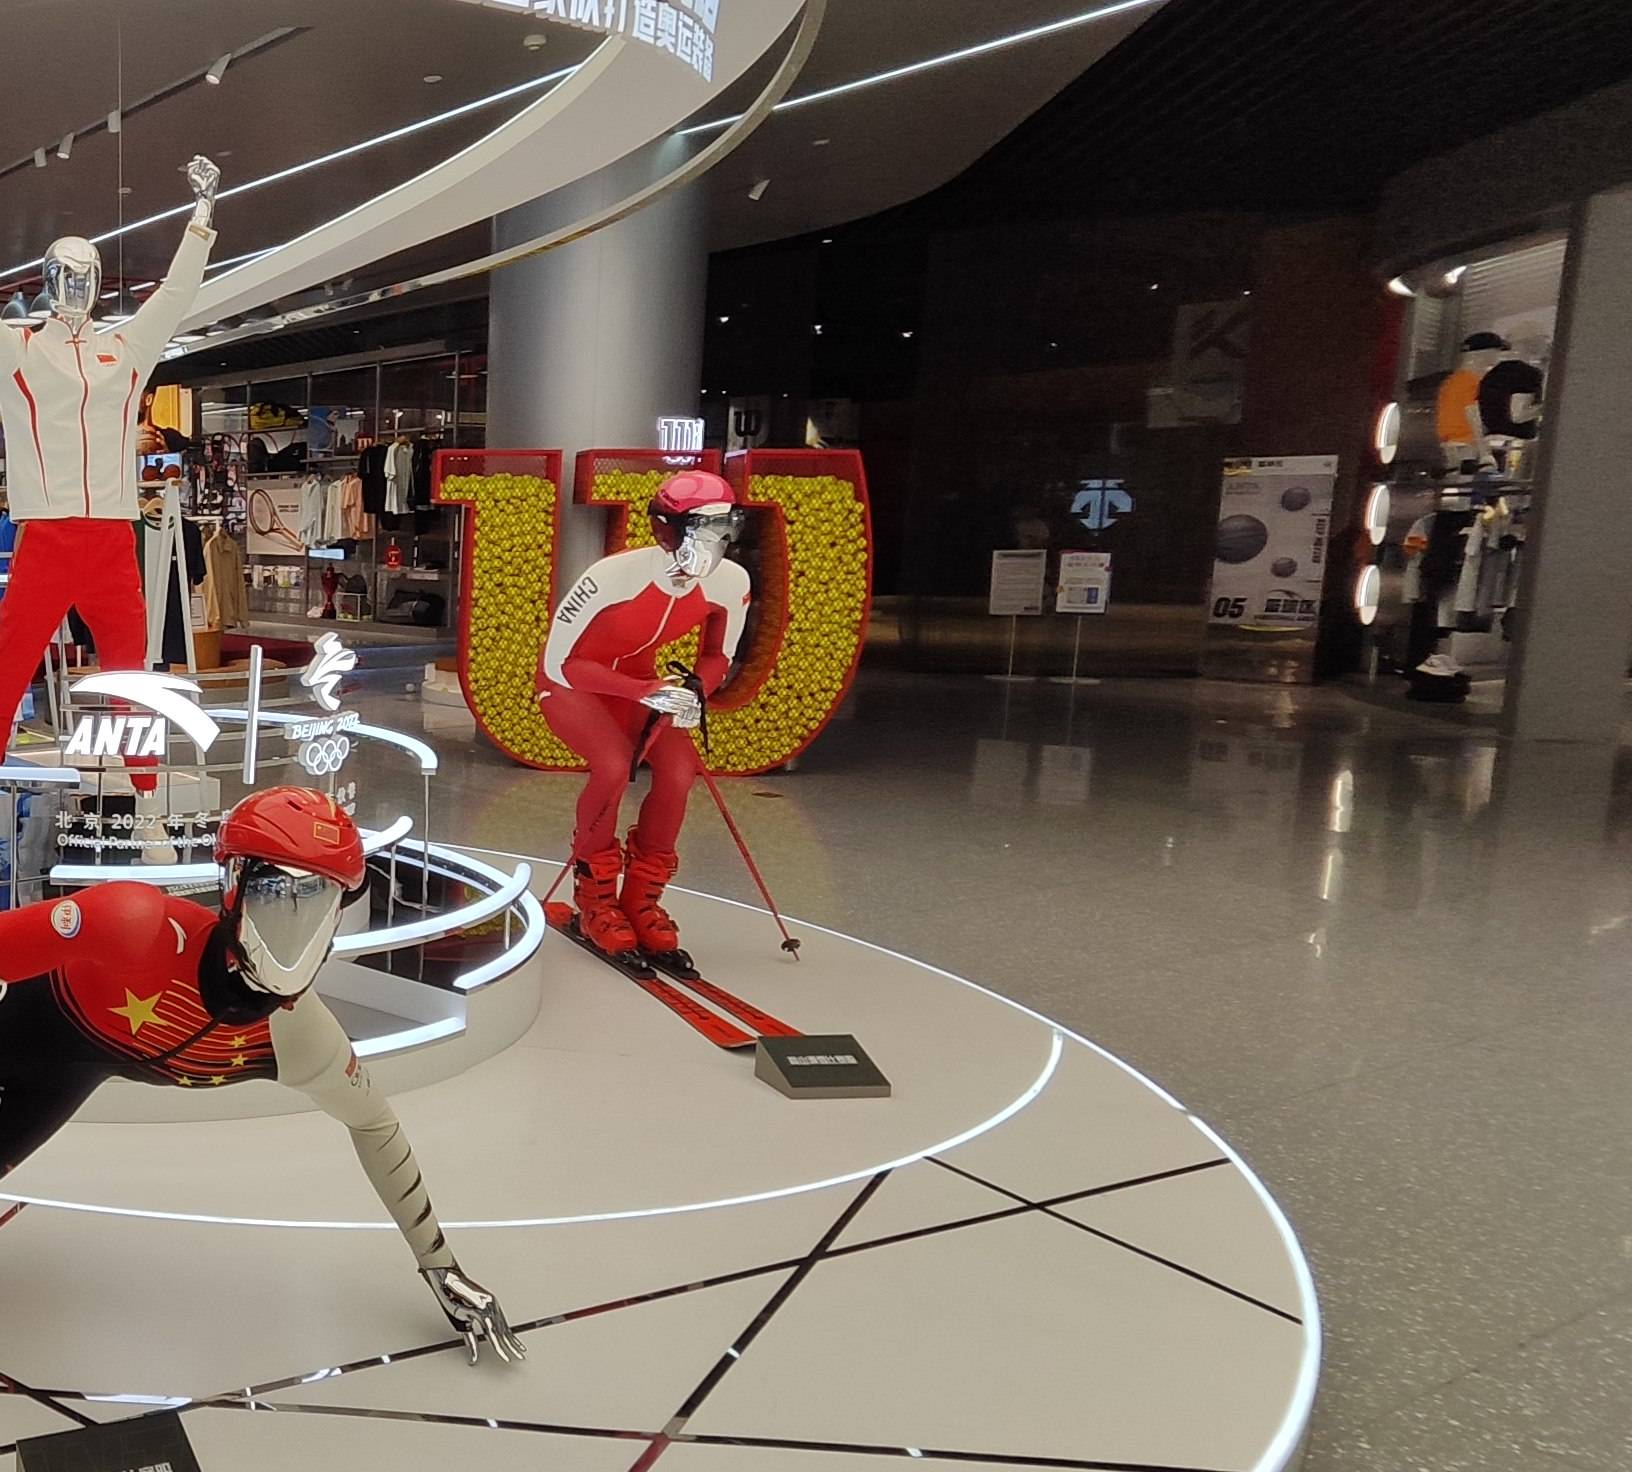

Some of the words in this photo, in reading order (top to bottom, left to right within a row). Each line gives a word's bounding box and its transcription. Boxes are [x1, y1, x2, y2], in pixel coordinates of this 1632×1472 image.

[557, 576, 599, 625] CHINA
[64, 717, 166, 756] ANTA
[292, 720, 334, 740] BEIJING
